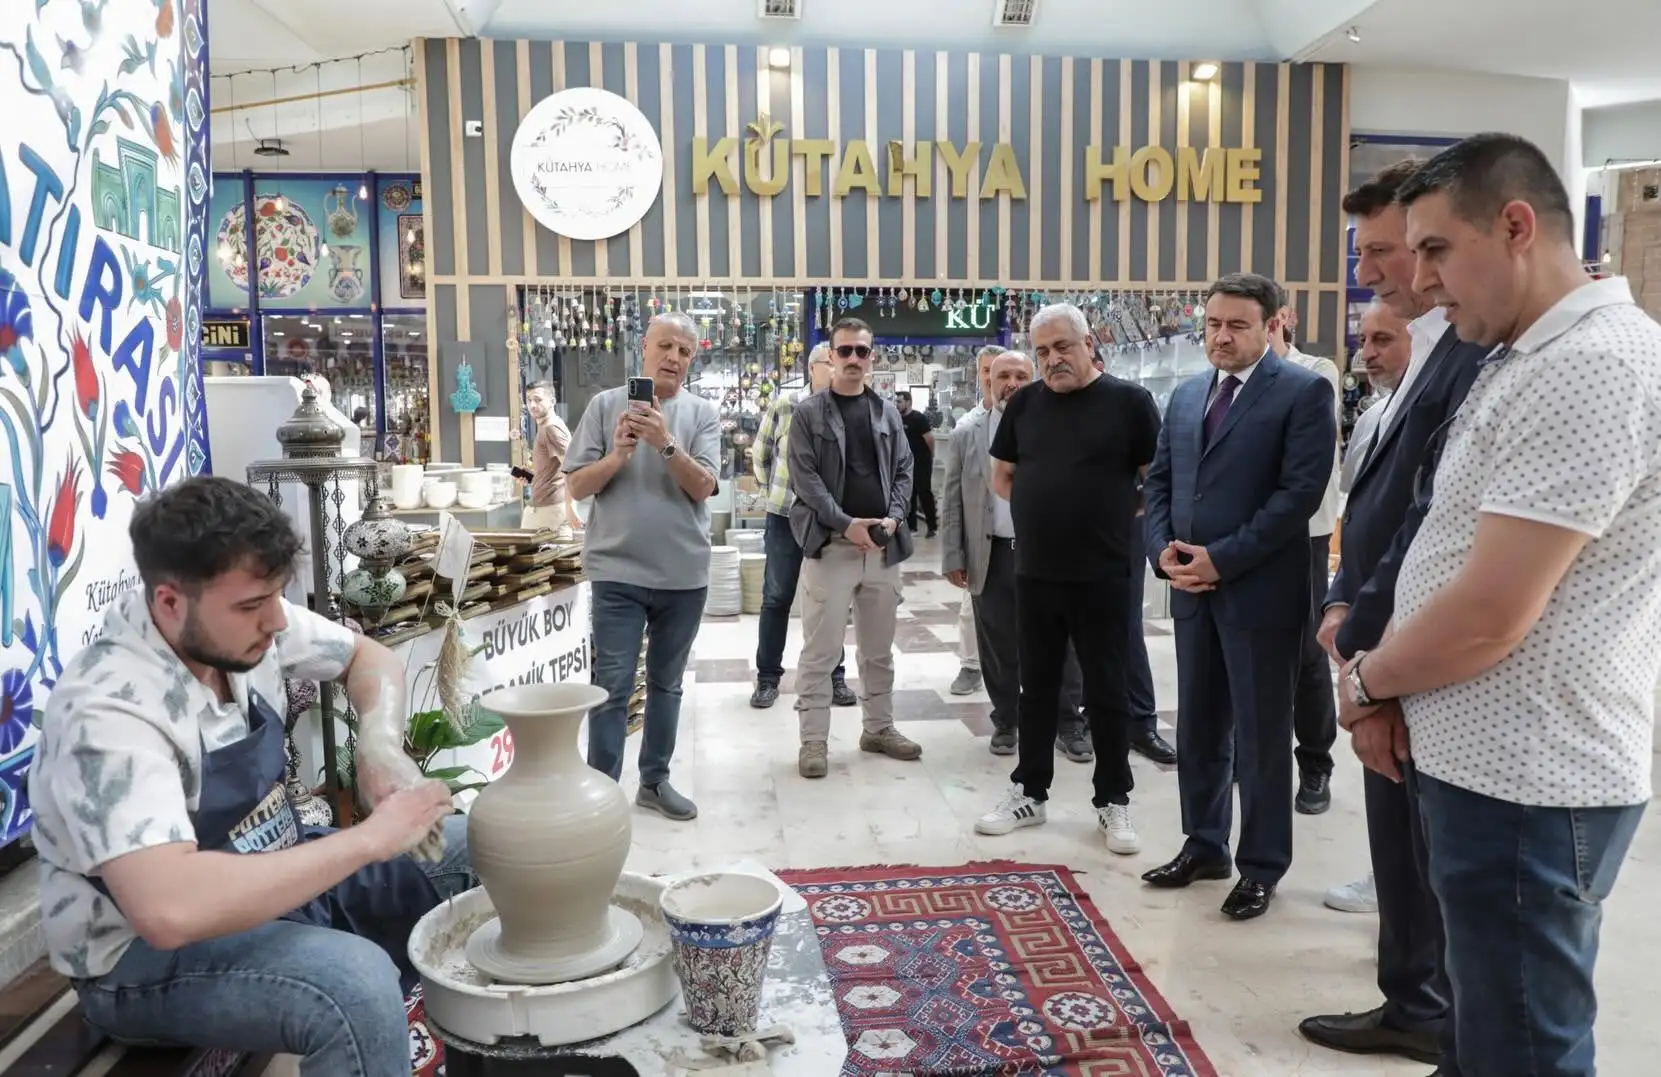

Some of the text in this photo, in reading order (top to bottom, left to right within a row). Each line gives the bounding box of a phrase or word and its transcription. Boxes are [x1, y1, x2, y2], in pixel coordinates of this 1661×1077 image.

[537, 157, 593, 173] KÜTAHYA
[692, 112, 1262, 203] KÜTAHYA HOME
[482, 600, 574, 661] BÜYÜK BOY
[549, 637, 588, 684] TEPSİ
